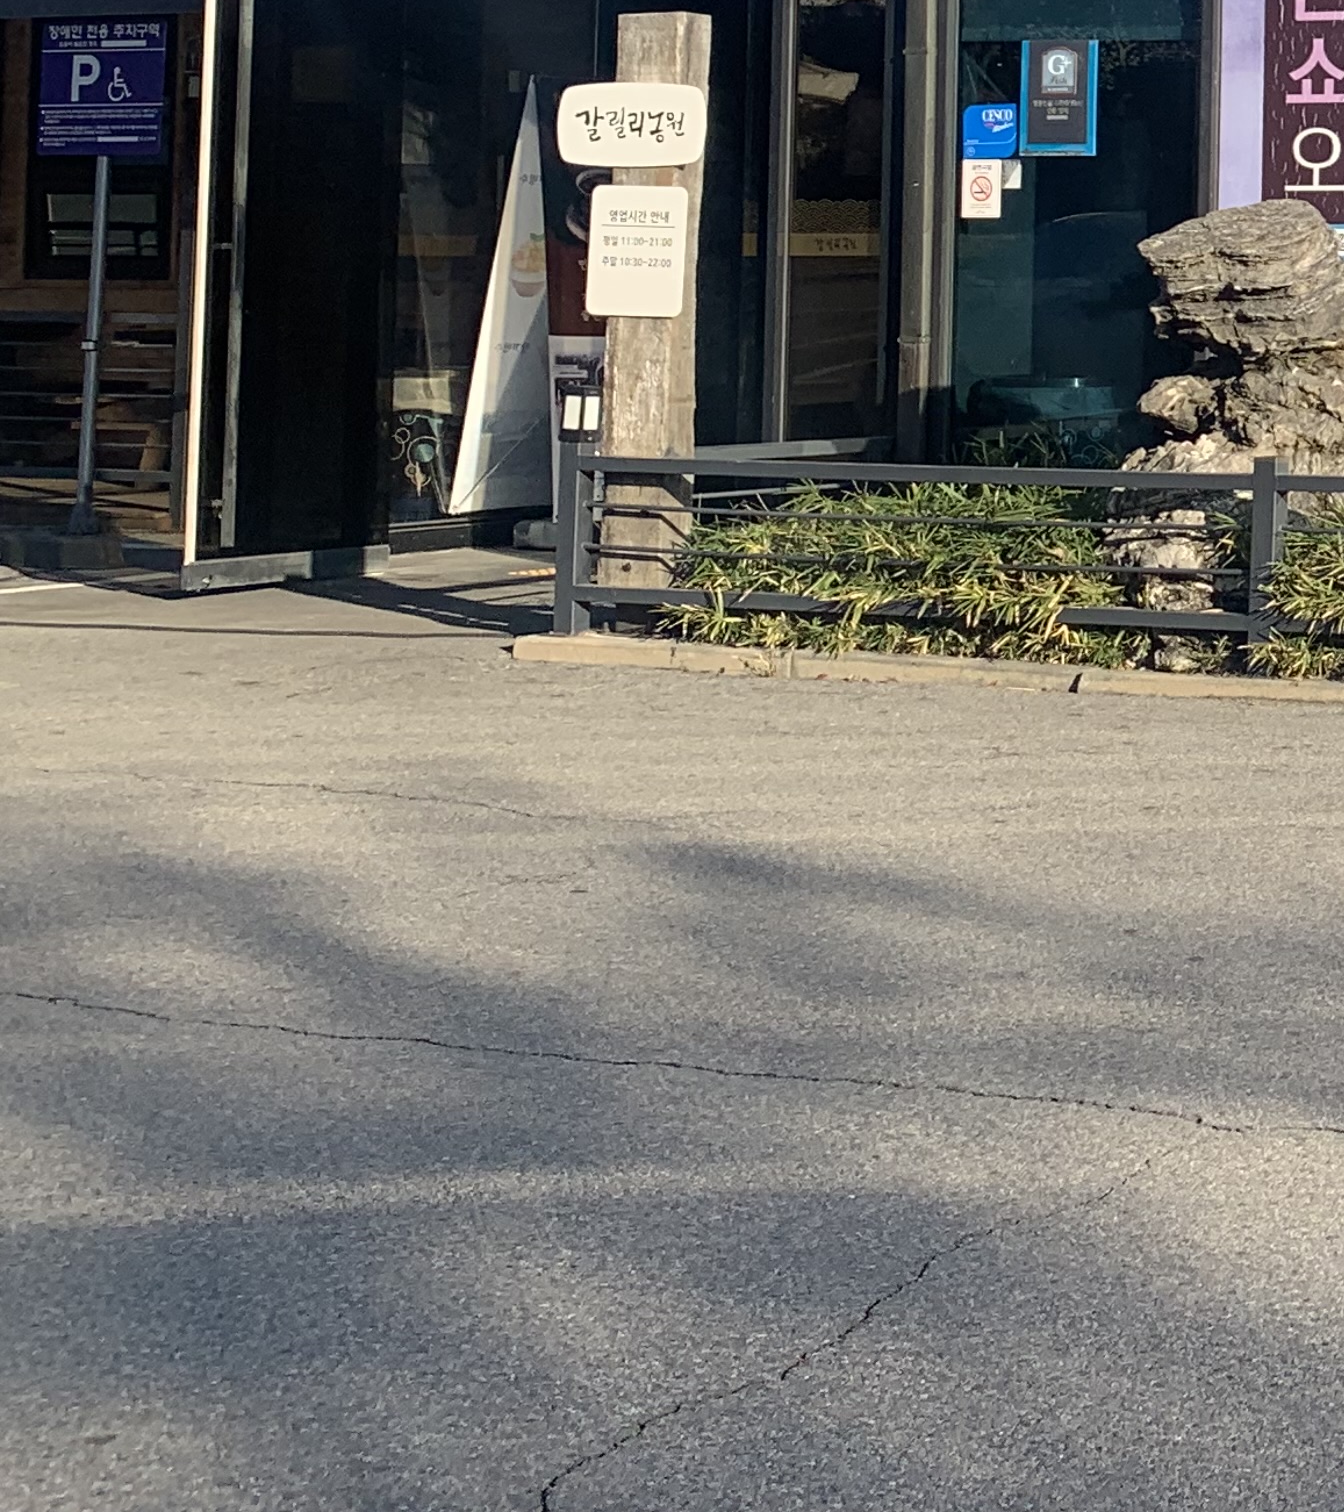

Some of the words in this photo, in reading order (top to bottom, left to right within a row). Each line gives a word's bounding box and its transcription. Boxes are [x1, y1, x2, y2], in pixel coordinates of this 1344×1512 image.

[48, 24, 82, 40] 장애인
[86, 24, 109, 39] 전용
[113, 23, 160, 38] 주차구역
[71, 54, 101, 102] P
[982, 108, 1013, 122] CESCO
[575, 106, 685, 143] 갈릴리농원
[609, 210, 647, 224] 영업시간
[650, 211, 670, 224] 안내
[602, 256, 618, 268] 주말
